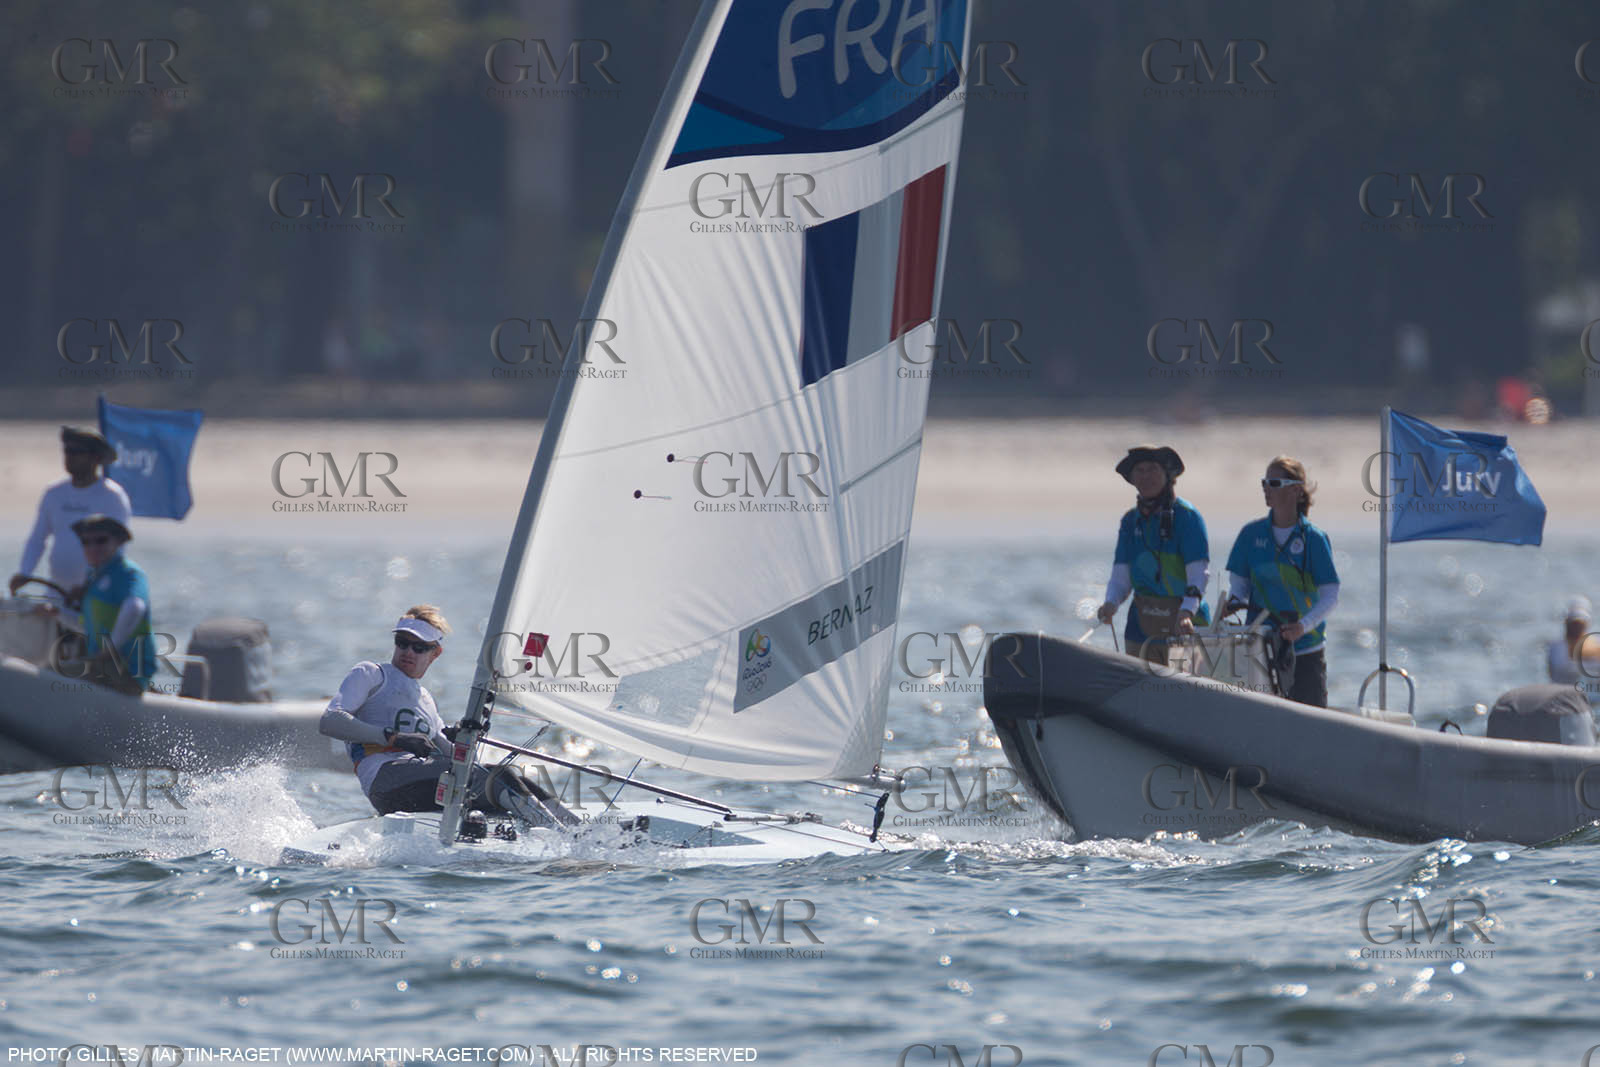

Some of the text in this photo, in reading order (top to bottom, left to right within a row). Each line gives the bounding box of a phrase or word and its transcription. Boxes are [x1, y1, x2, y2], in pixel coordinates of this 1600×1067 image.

[778, 0, 935, 98] FRA
[1442, 463, 1501, 497] Jury
[808, 585, 873, 646] BERNAZ
